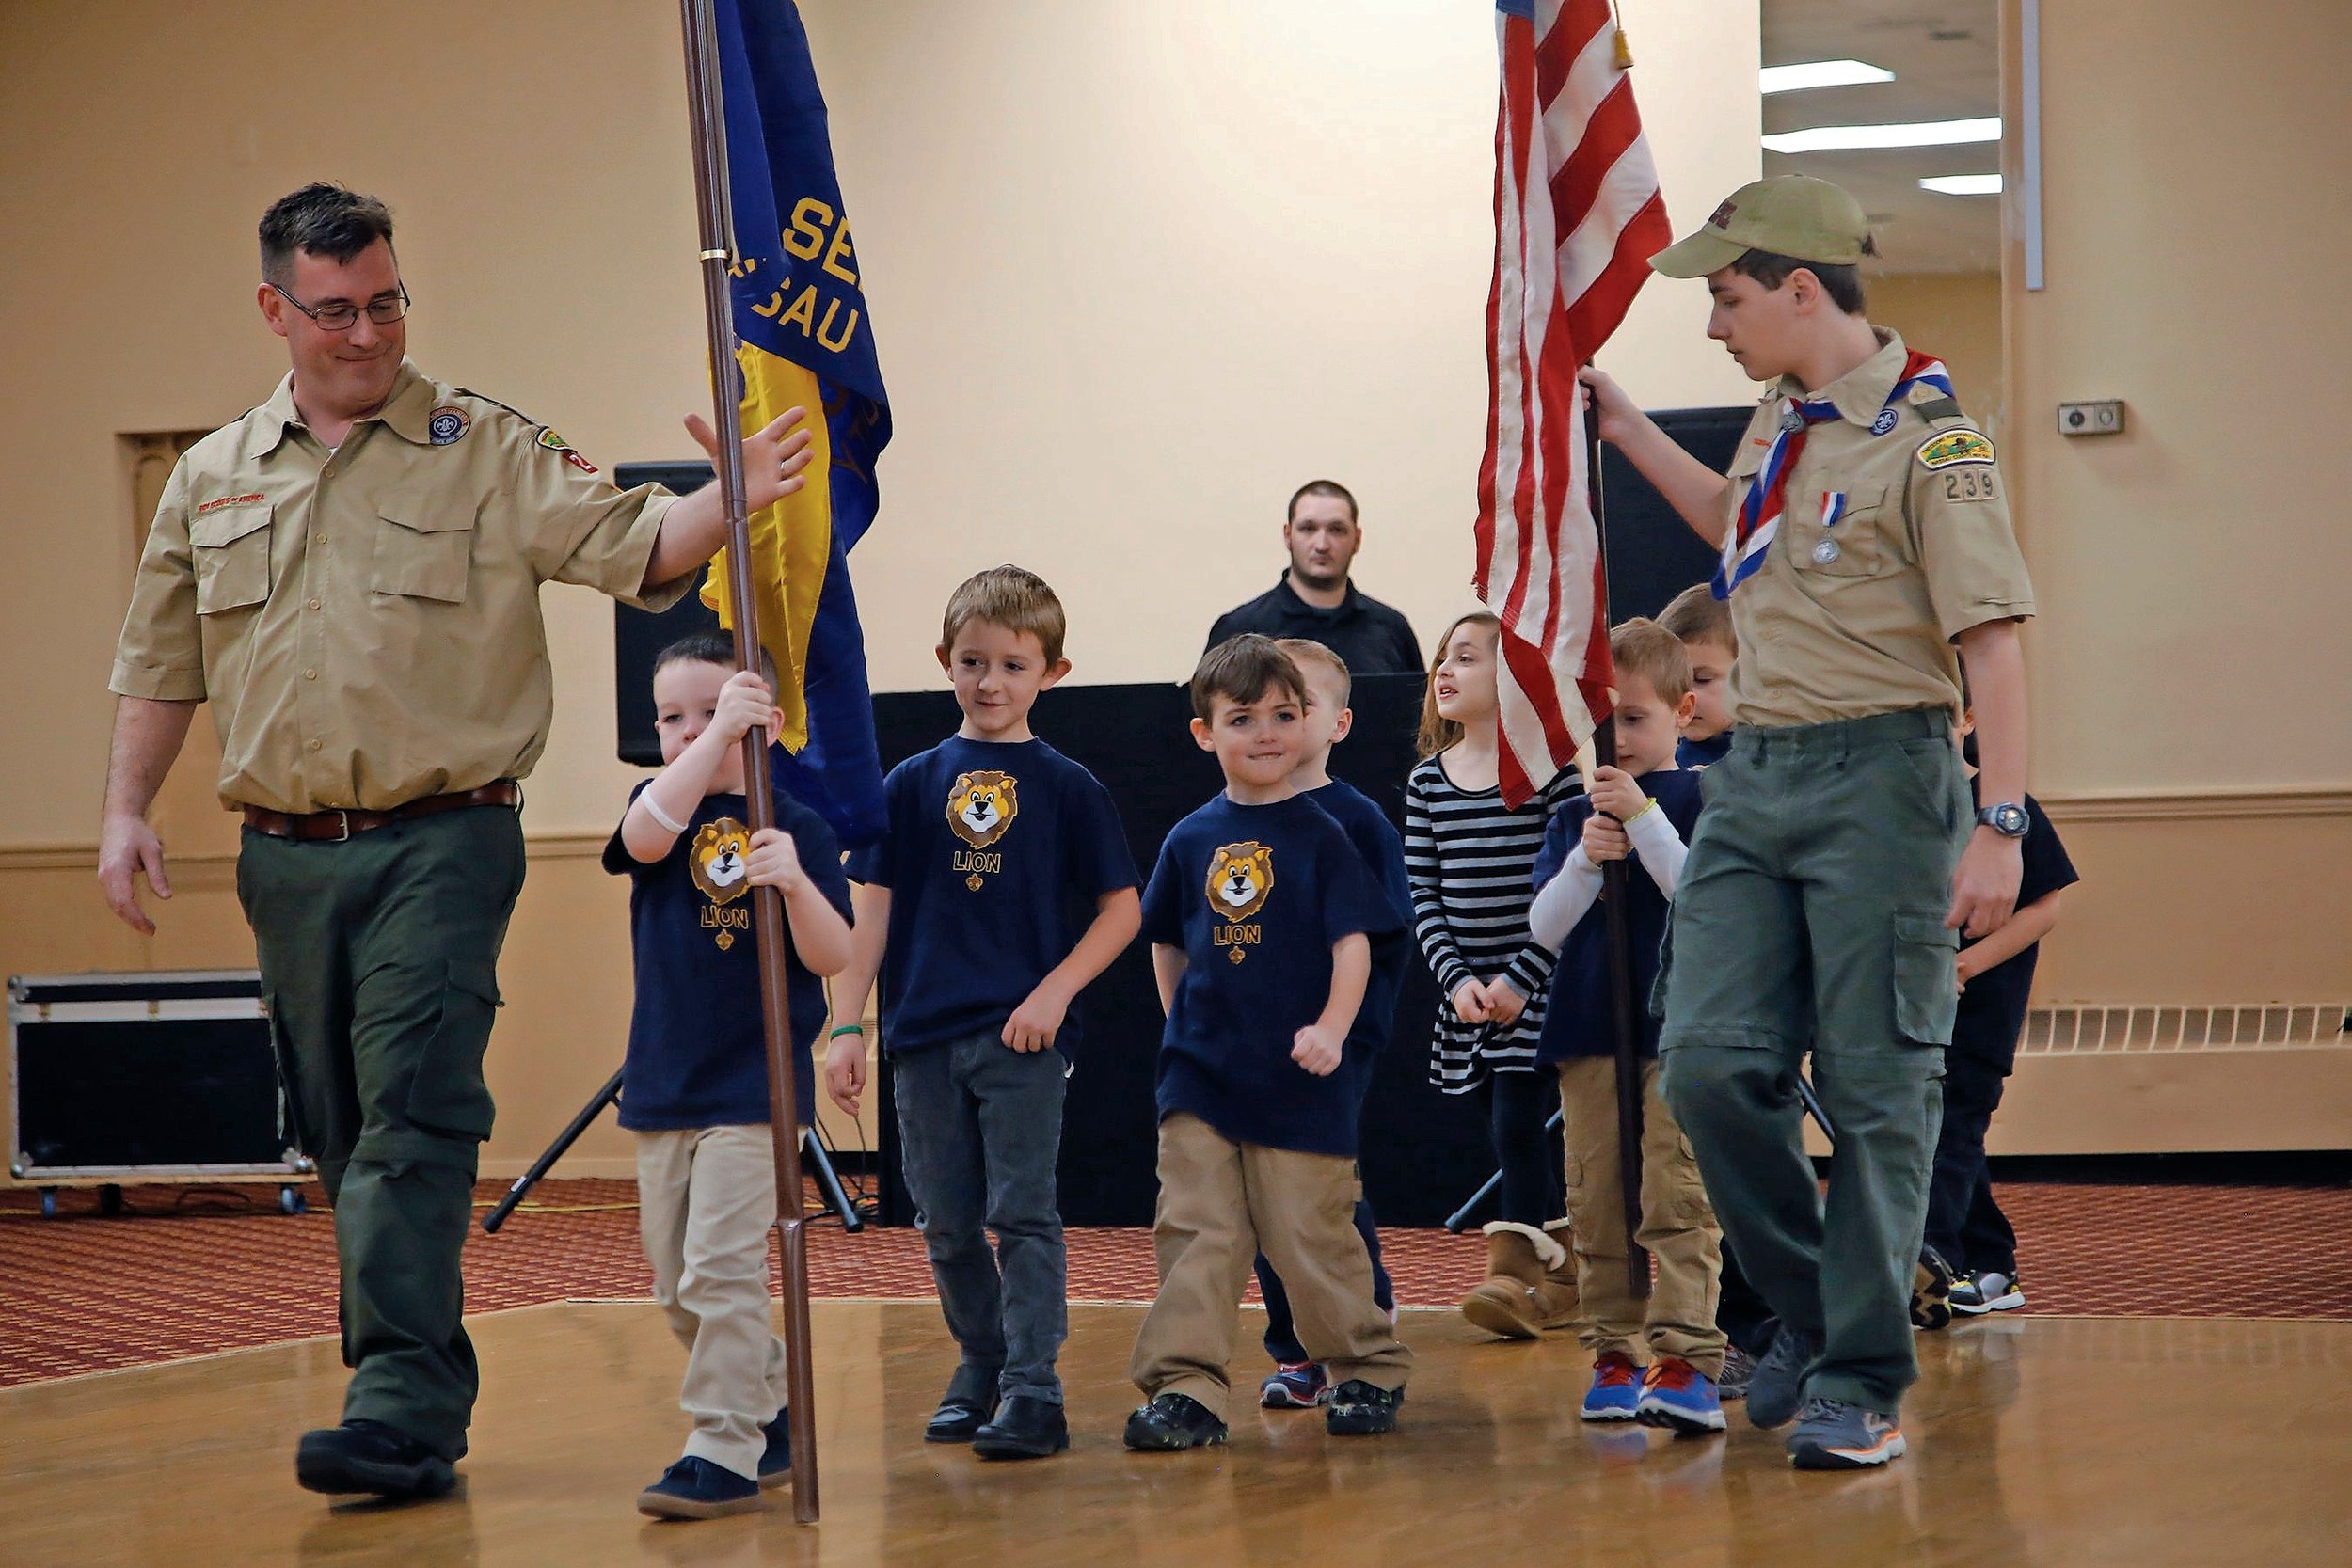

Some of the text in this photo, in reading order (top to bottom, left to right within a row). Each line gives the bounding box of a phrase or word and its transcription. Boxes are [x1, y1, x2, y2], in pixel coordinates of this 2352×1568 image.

[1944, 472, 1993, 499] 239
[952, 850, 1002, 874] LION
[700, 905, 750, 930] LION
[1213, 924, 1262, 946] LION
